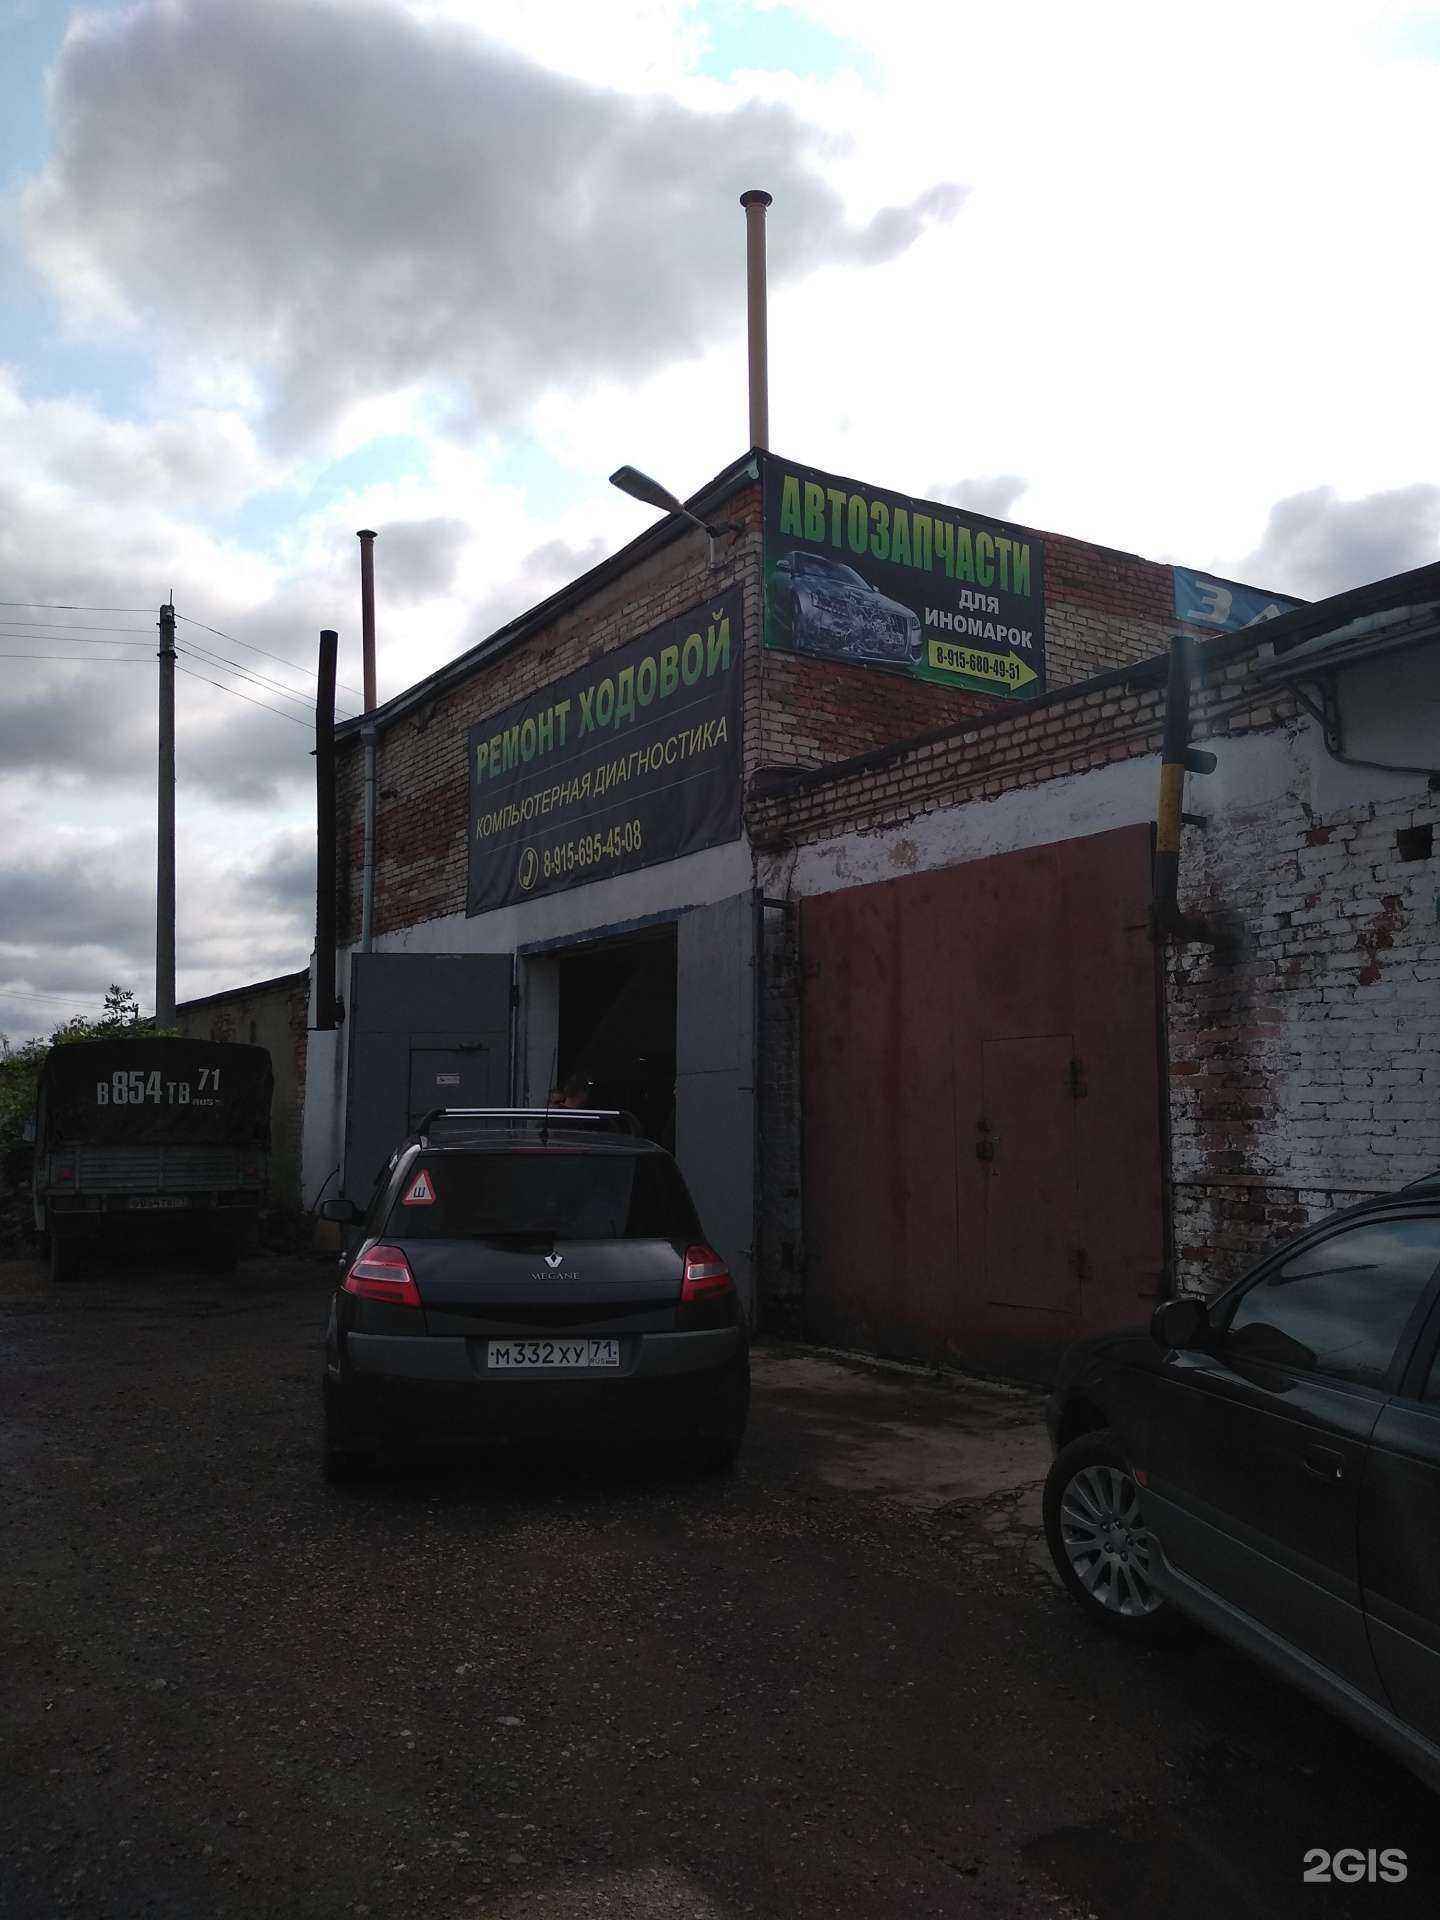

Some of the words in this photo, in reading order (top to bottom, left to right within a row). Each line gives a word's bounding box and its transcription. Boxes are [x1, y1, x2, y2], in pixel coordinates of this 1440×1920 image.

[779, 475, 1031, 596] АВТОЗАПЧАСТИ
[959, 589, 999, 615] ДЛЯ
[925, 608, 1033, 649] ИНОМАРОК
[936, 647, 1020, 681] 8-915-680-49-51
[476, 699, 571, 784] РЕМОНТ
[577, 608, 731, 738] ХОДОВОЙ
[476, 770, 592, 839] КОМПЬЮТЕРНАЯ
[593, 716, 728, 798] ДИАГНОСТИКА
[543, 820, 642, 877] 8-915-695-45-08
[413, 1187, 426, 1199] Ш
[529, 1271, 580, 1281] MEGANE
